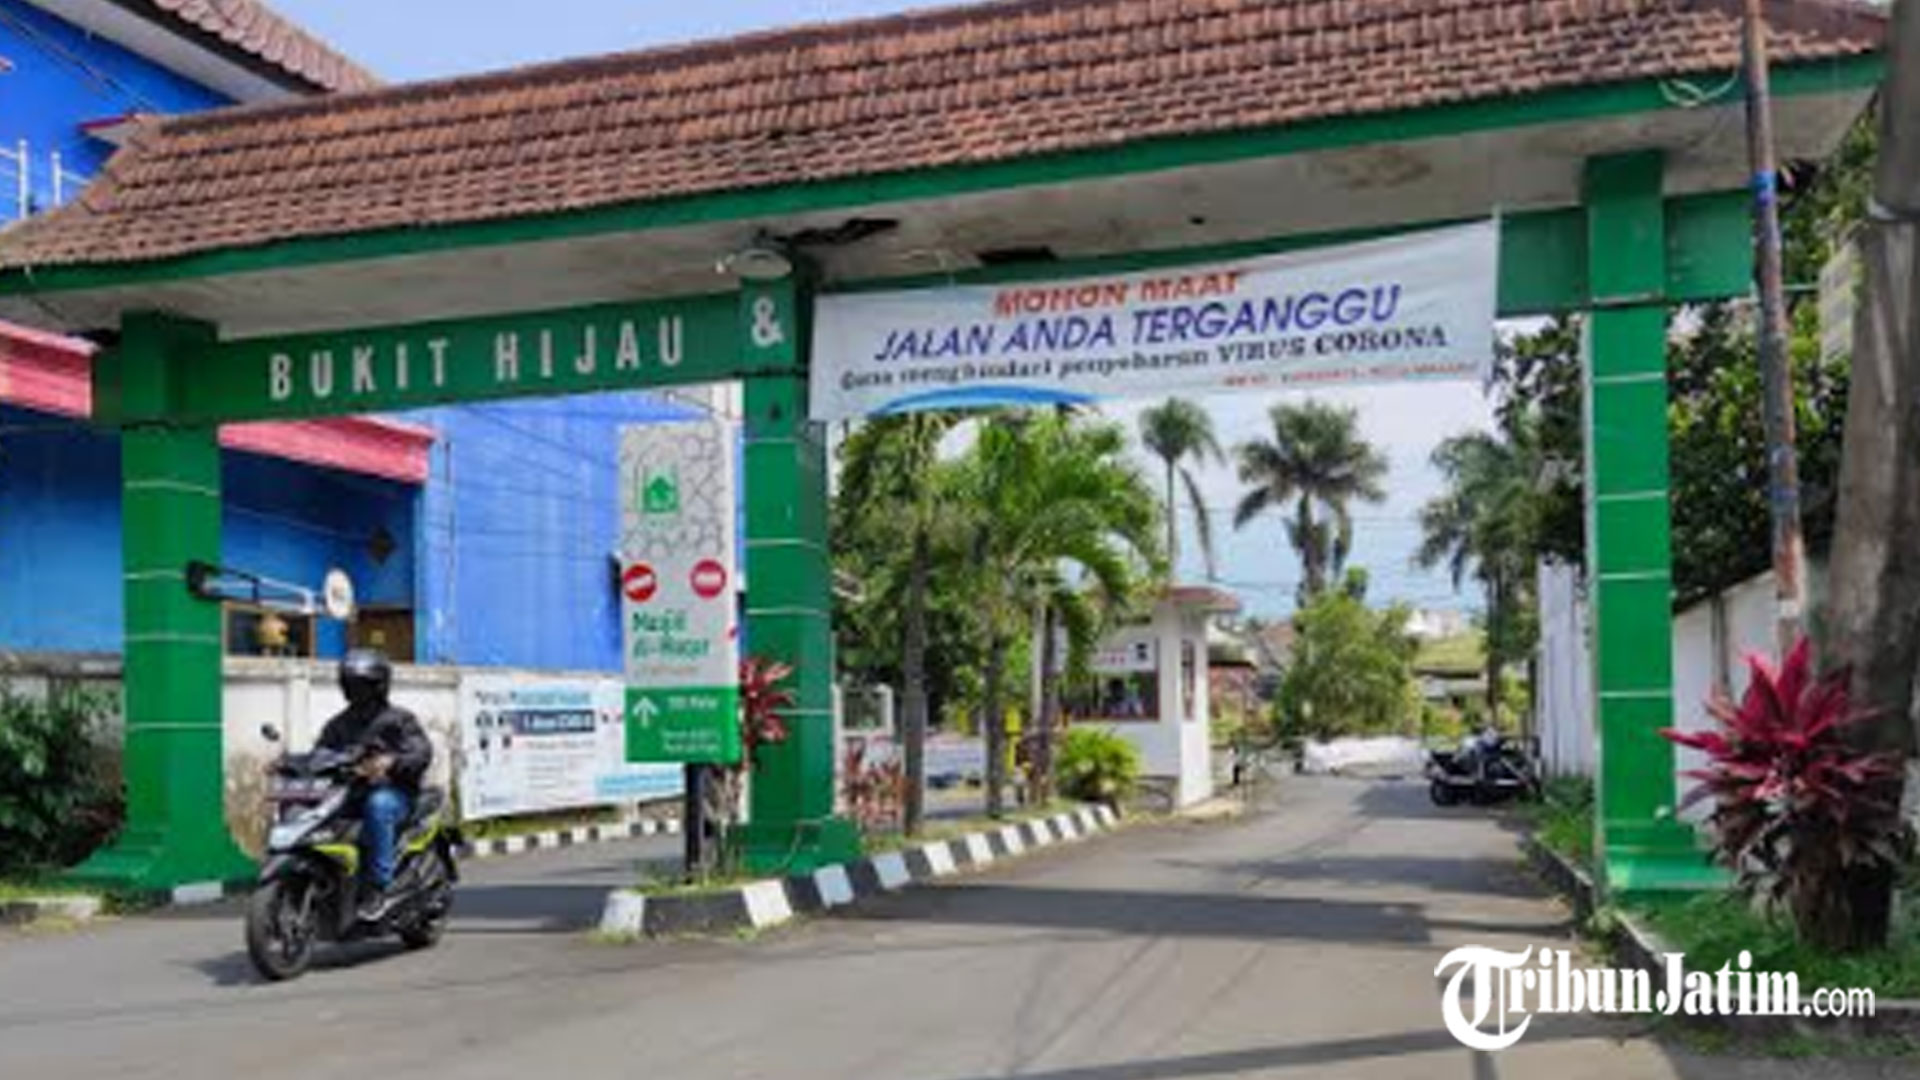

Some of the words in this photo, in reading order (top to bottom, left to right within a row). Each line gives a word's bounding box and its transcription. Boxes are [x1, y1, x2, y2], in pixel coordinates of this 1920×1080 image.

[873, 324, 994, 361] JALAN
[1002, 312, 1117, 352] ANDA
[1131, 284, 1401, 346] TERGANGGU
[993, 280, 1128, 317] MOHON
[269, 338, 449, 400] BUKIT
[495, 316, 683, 382] HIJAU
[750, 296, 784, 347] &
[1218, 337, 1305, 363] VIRUS
[1314, 325, 1448, 356] CORONA
